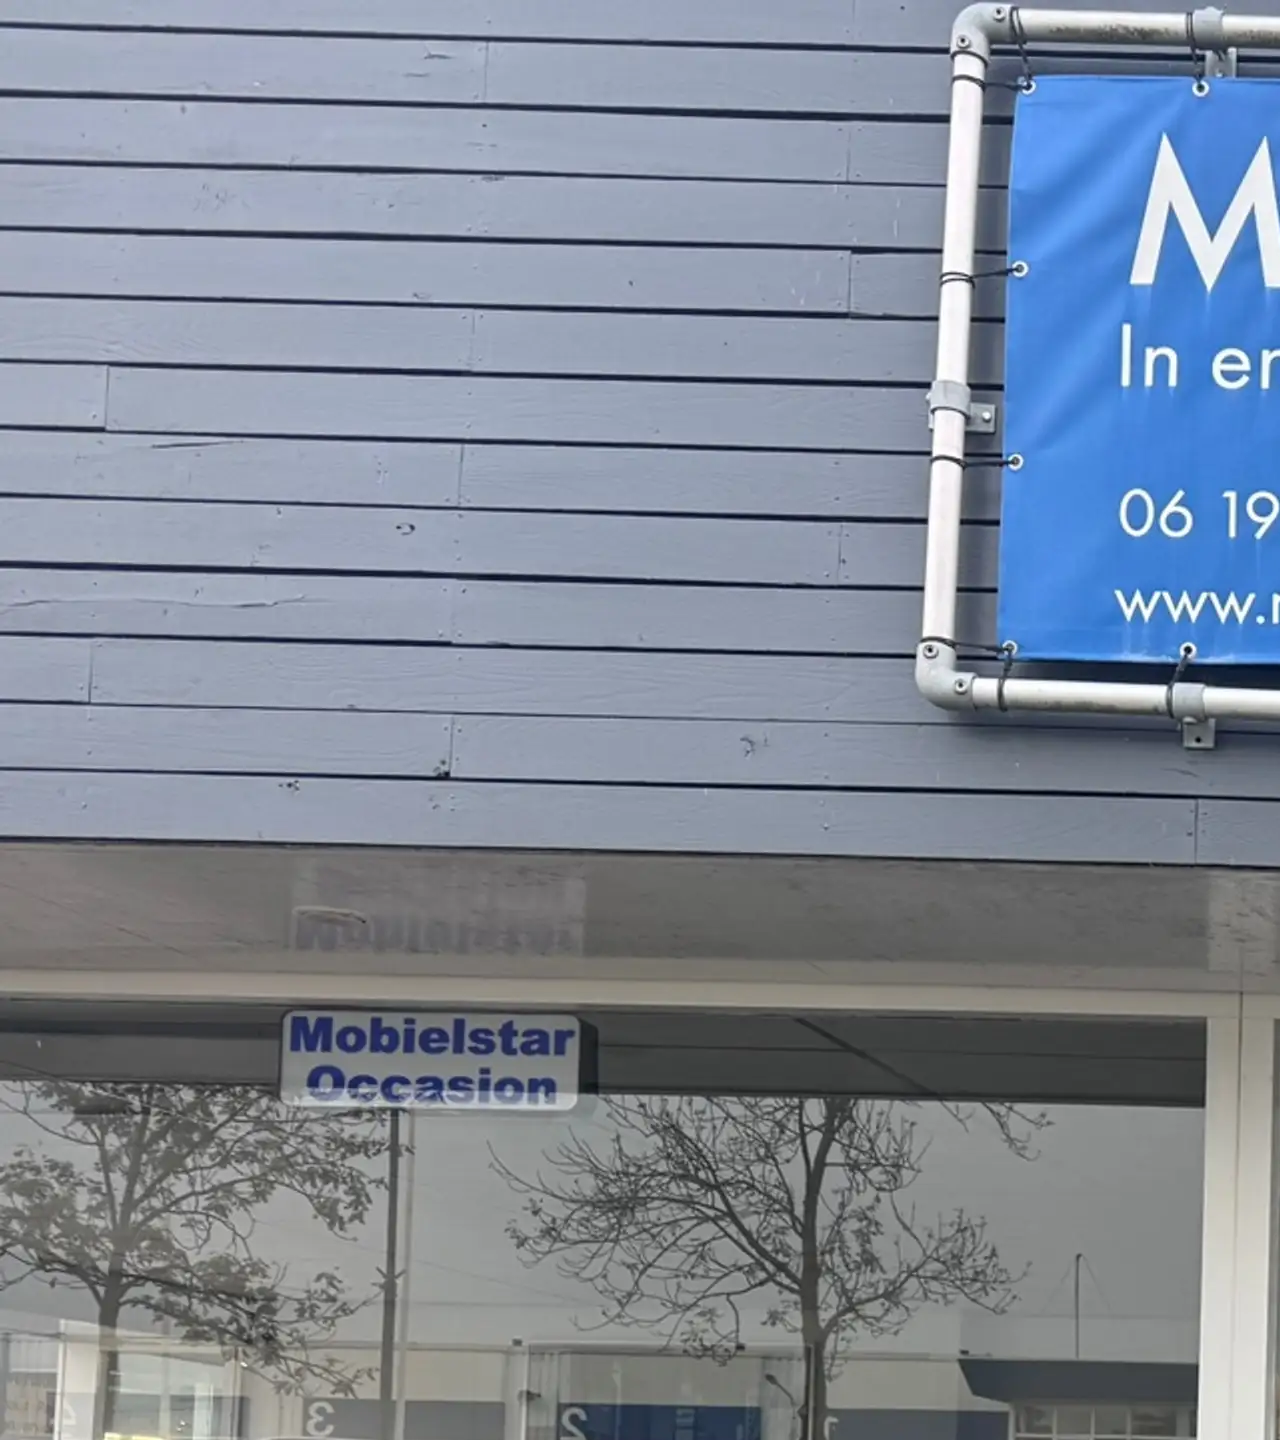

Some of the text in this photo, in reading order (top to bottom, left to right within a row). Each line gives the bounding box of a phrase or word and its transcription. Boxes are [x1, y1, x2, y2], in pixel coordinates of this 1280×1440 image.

[1121, 323, 1178, 388] In
[1119, 488, 1193, 538] 06
[289, 1015, 576, 1057] Mobielstar
[305, 1064, 558, 1107] Occasion
